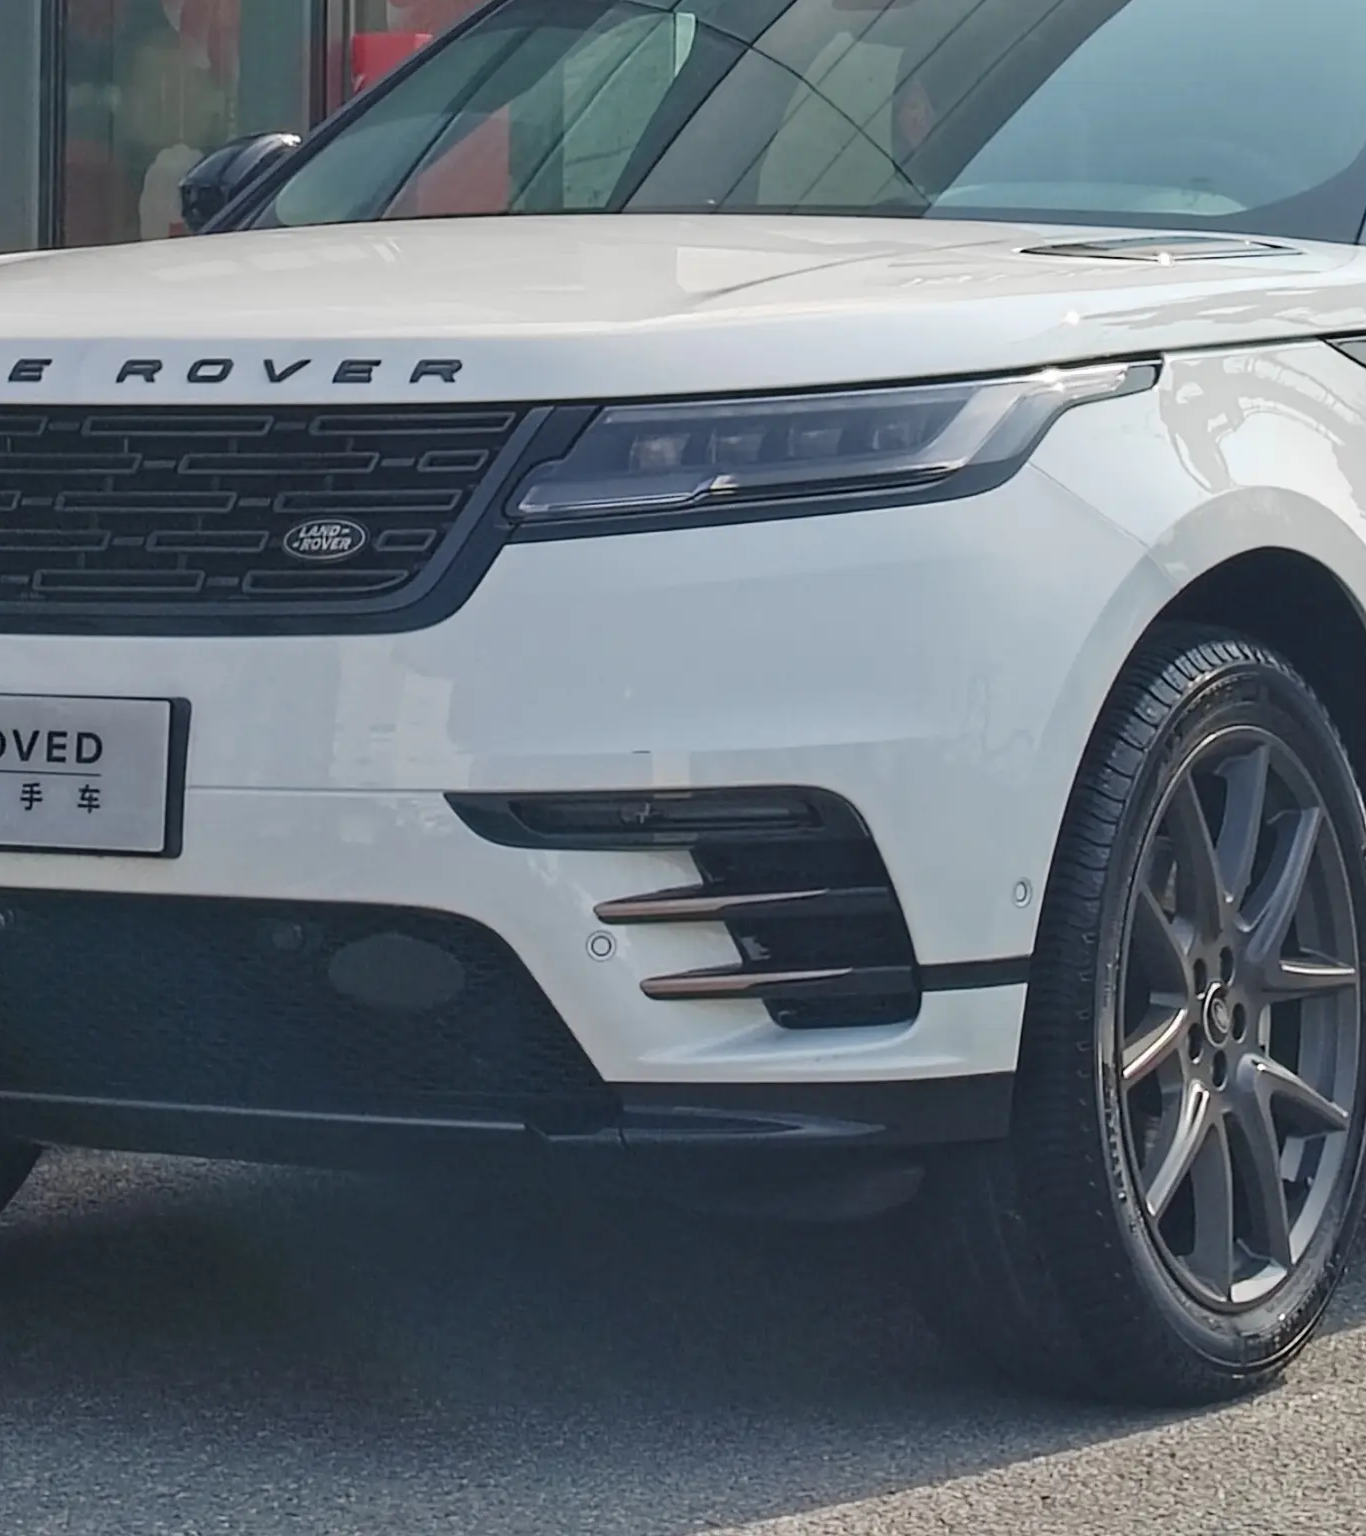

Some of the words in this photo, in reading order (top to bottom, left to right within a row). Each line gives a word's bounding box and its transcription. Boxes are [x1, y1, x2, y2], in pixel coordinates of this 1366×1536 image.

[115, 358, 463, 384] ROVER
[299, 524, 341, 538] LAND
[299, 537, 352, 551] ROVER
